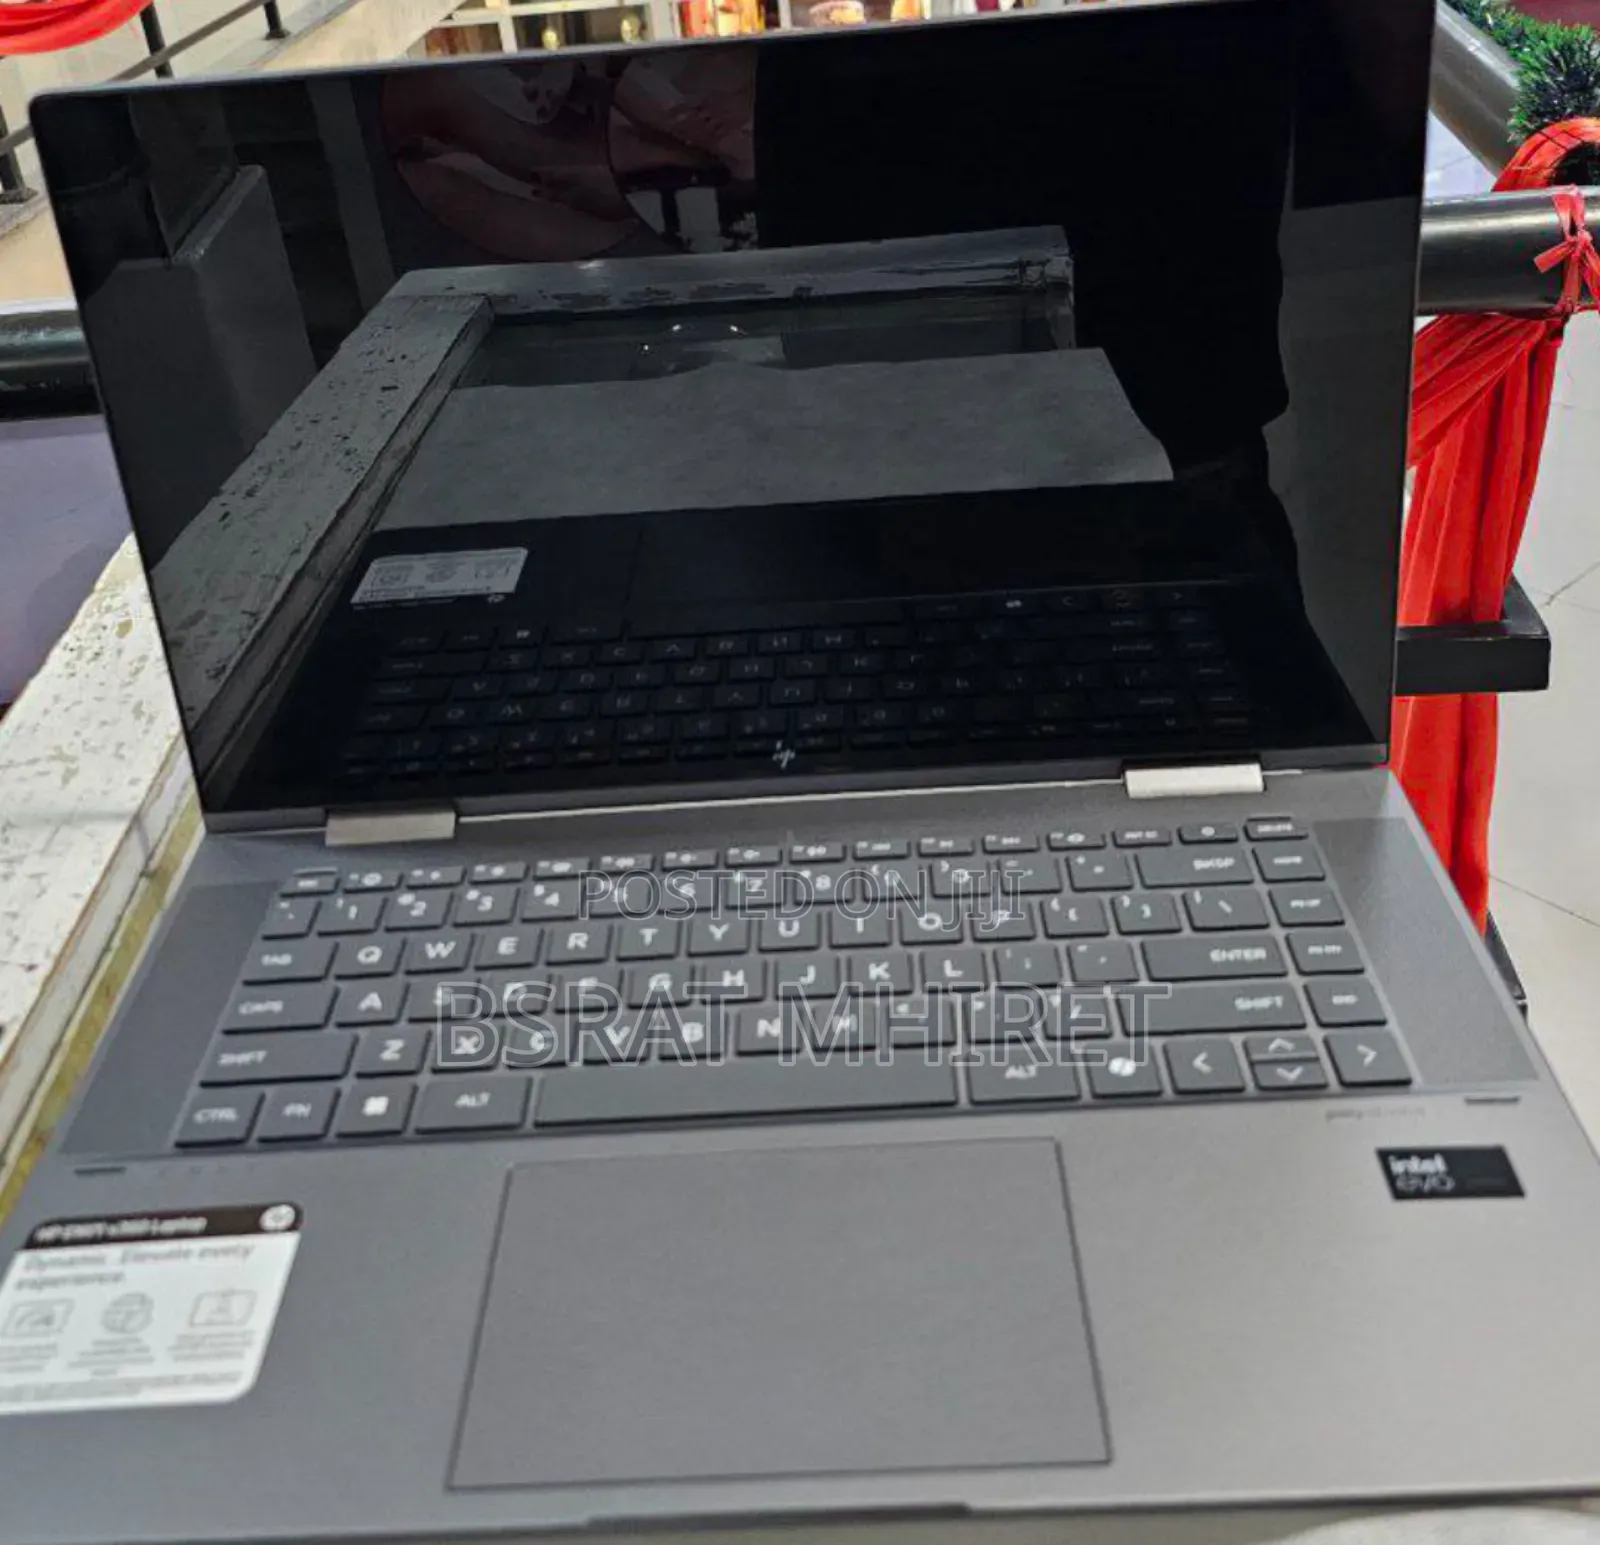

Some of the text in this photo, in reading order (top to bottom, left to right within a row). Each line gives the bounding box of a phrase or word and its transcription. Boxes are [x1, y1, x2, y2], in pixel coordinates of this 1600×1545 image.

[816, 876, 831, 889] 8
[478, 896, 493, 911] 3
[544, 892, 559, 906] 4
[410, 902, 426, 916] 2
[778, 919, 800, 938] U
[918, 912, 942, 931] O
[567, 932, 589, 949] R
[639, 928, 659, 946] T
[709, 924, 729, 940] Y
[425, 941, 456, 959] W
[498, 937, 519, 954] E
[261, 954, 292, 966] TAB
[357, 946, 382, 964] Q
[1209, 947, 1267, 962] ENTER
[799, 965, 816, 984] J
[869, 962, 890, 980] K
[944, 960, 963, 978] L
[722, 969, 745, 987] H
[358, 992, 382, 1011] A
[1235, 996, 1283, 1011] SHIFT
[605, 1026, 631, 1046] V
[756, 1018, 781, 1038] N
[379, 1039, 405, 1061] Z
[454, 1035, 480, 1054] X
[217, 1051, 268, 1066] SHIFT
[1005, 1064, 1038, 1079] ALT
[455, 1092, 491, 1108] ALT
[194, 1107, 238, 1123] CTRL
[282, 1103, 312, 1118] FN
[1389, 1153, 1448, 1174] intel
